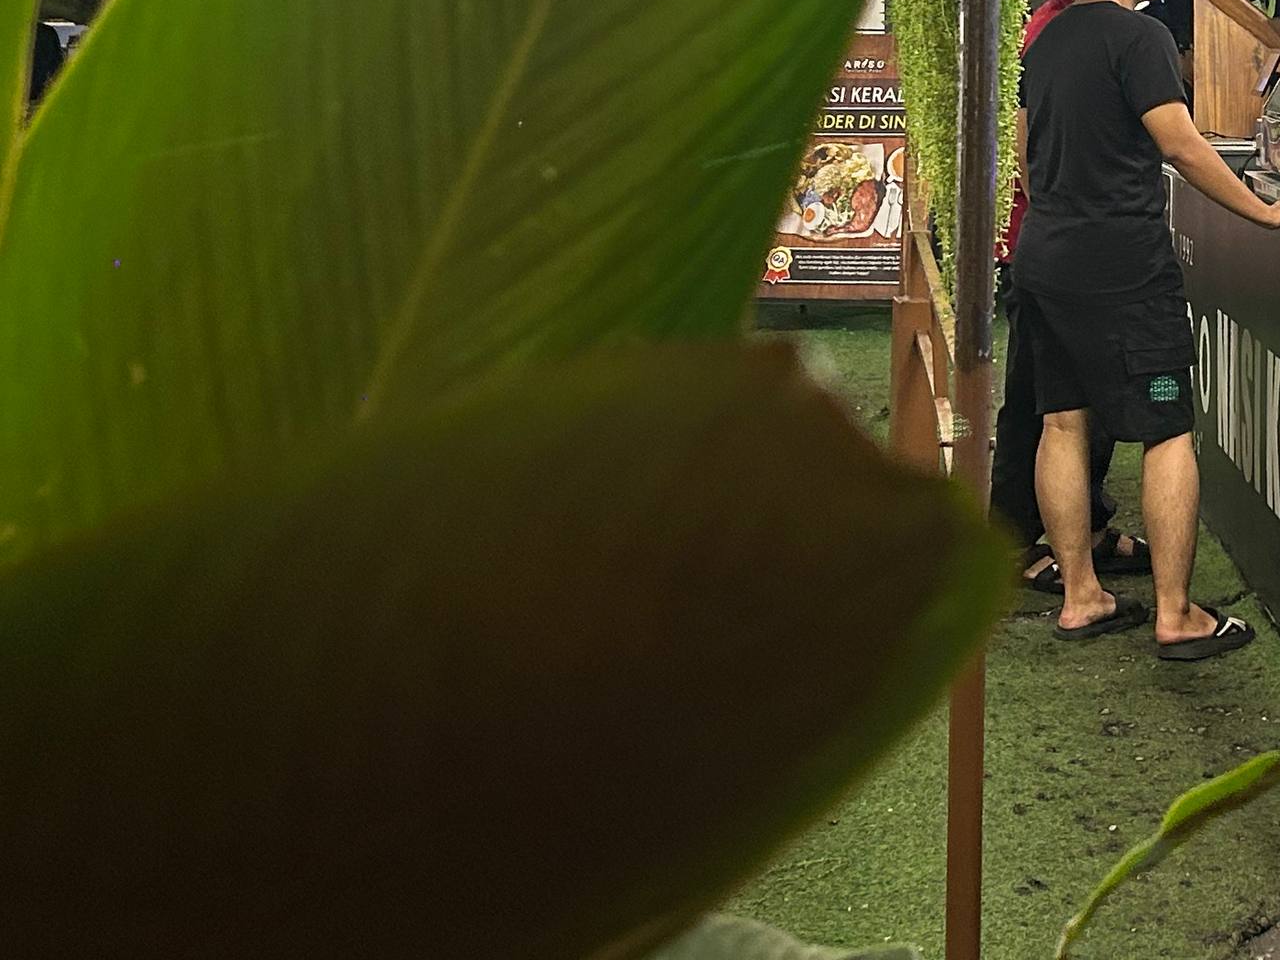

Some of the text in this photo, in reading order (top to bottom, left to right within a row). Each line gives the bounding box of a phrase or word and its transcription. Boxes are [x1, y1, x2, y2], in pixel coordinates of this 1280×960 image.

[844, 59, 885, 69] ARISO
[851, 87, 905, 103] KERA
[819, 114, 906, 130] DER DI SIN
[1217, 308, 1261, 495] NASI
